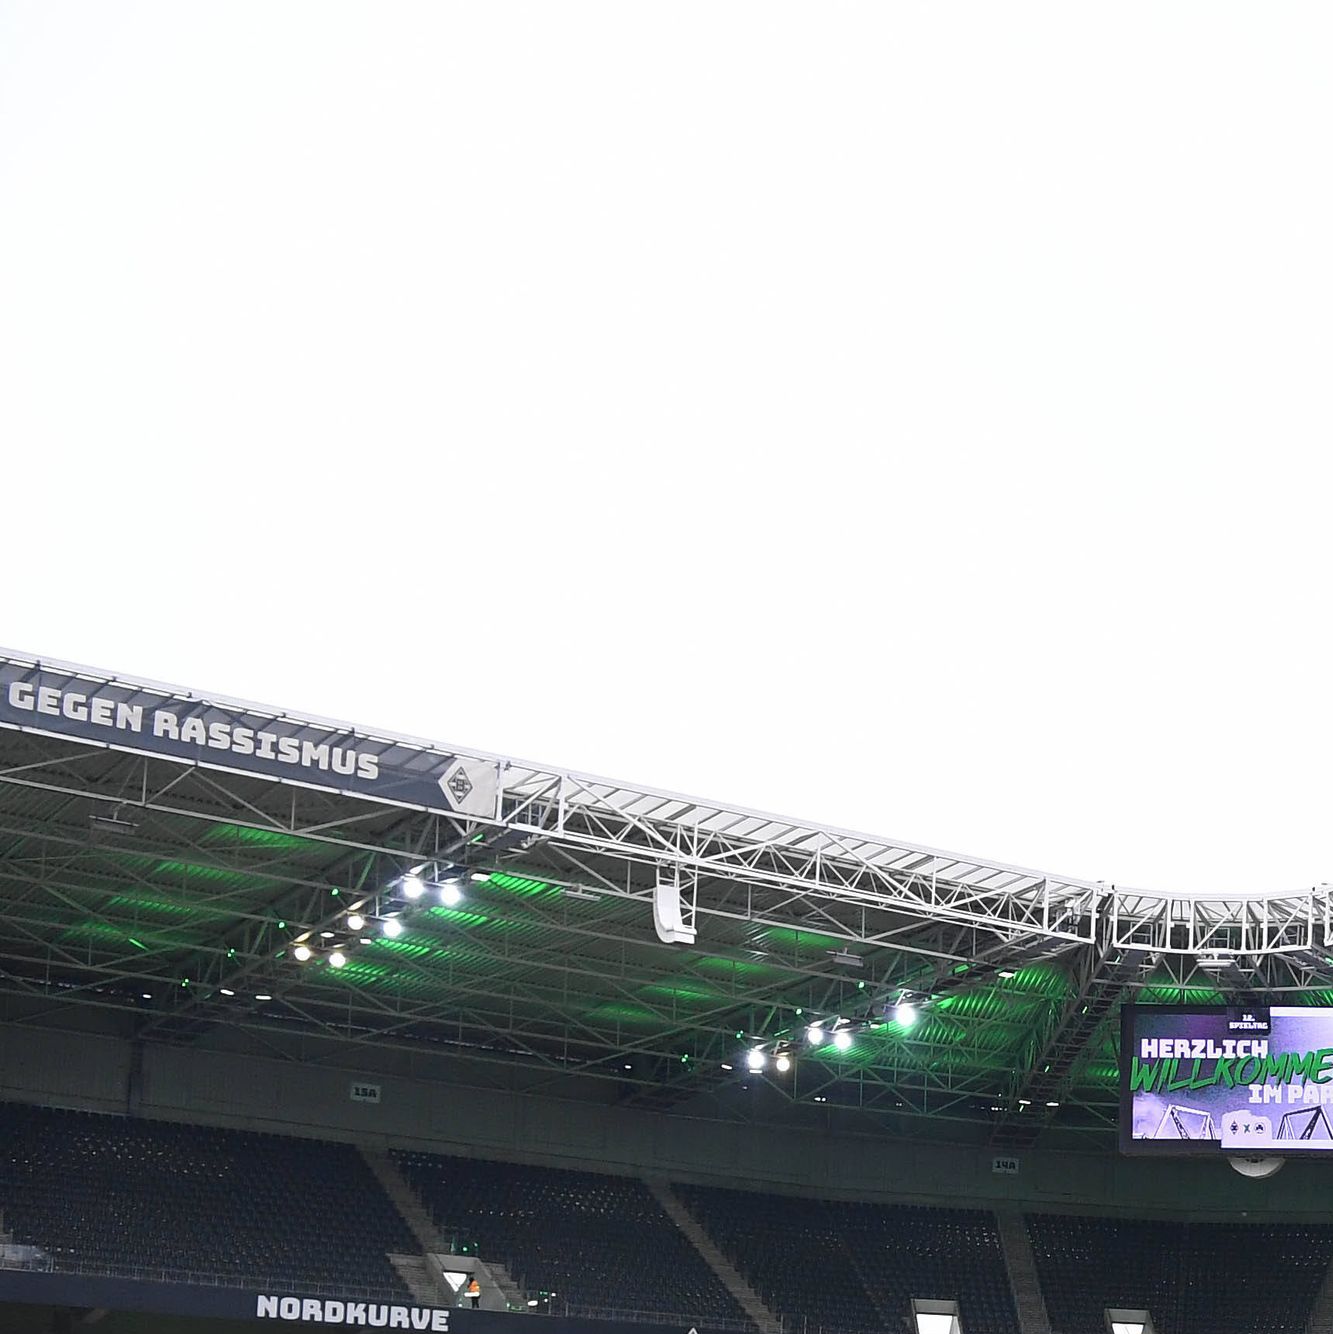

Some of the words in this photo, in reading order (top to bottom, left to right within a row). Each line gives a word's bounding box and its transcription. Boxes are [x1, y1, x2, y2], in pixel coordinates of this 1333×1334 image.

[8, 681, 143, 732] GEGEN
[153, 709, 380, 780] RASSISMUS
[1140, 1038, 1268, 1059] HERZLICH
[1248, 1084, 1282, 1104] IM
[256, 1295, 450, 1332] NORDKURVE
